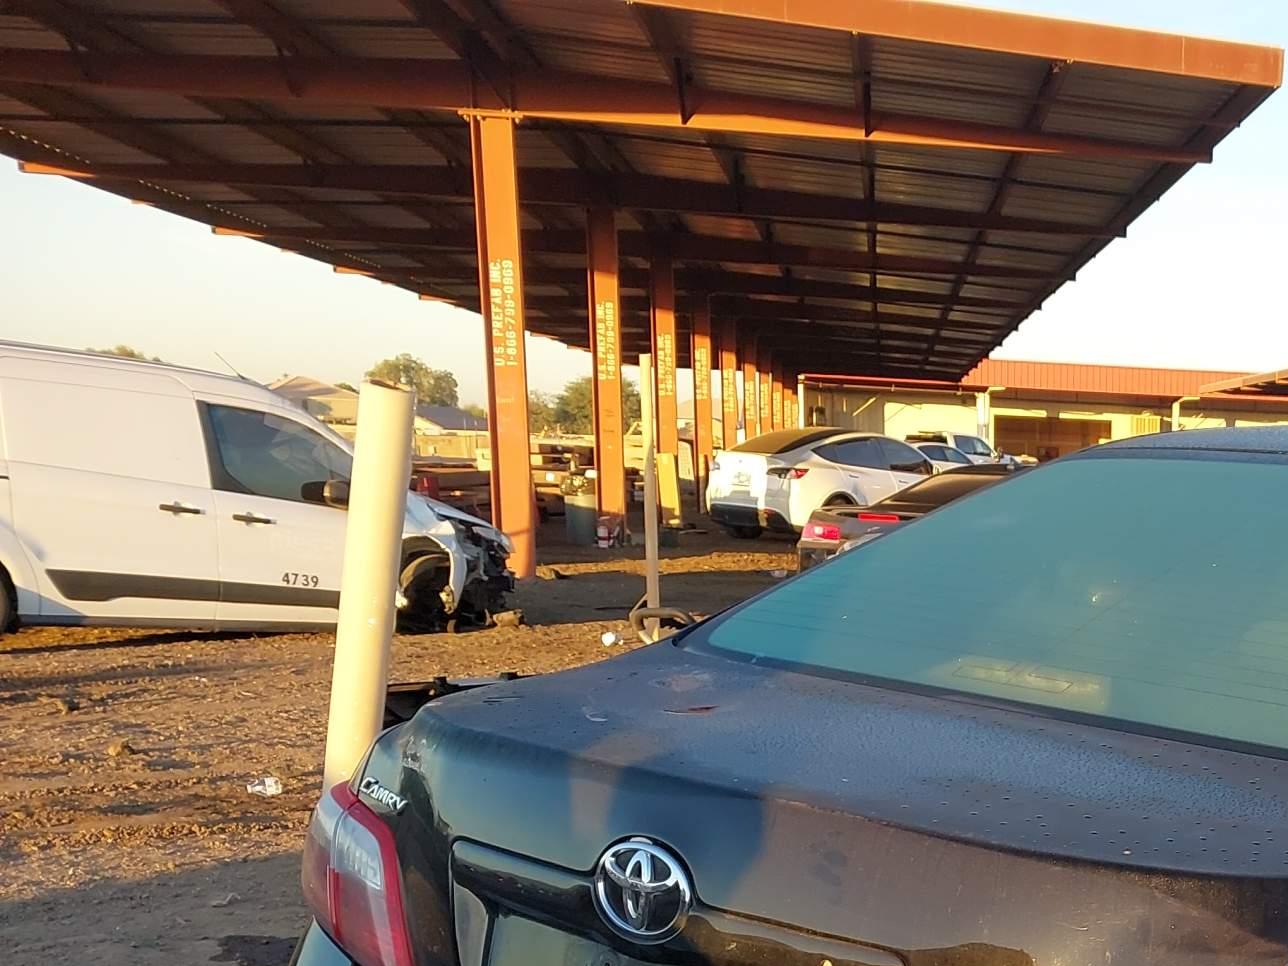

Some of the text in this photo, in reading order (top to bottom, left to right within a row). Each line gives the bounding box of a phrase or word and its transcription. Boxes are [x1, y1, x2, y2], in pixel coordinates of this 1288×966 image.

[488, 258, 502, 284] INC.
[490, 287, 504, 337] PREFAB
[281, 572, 319, 588] 4739
[359, 776, 409, 811] CAMRY
